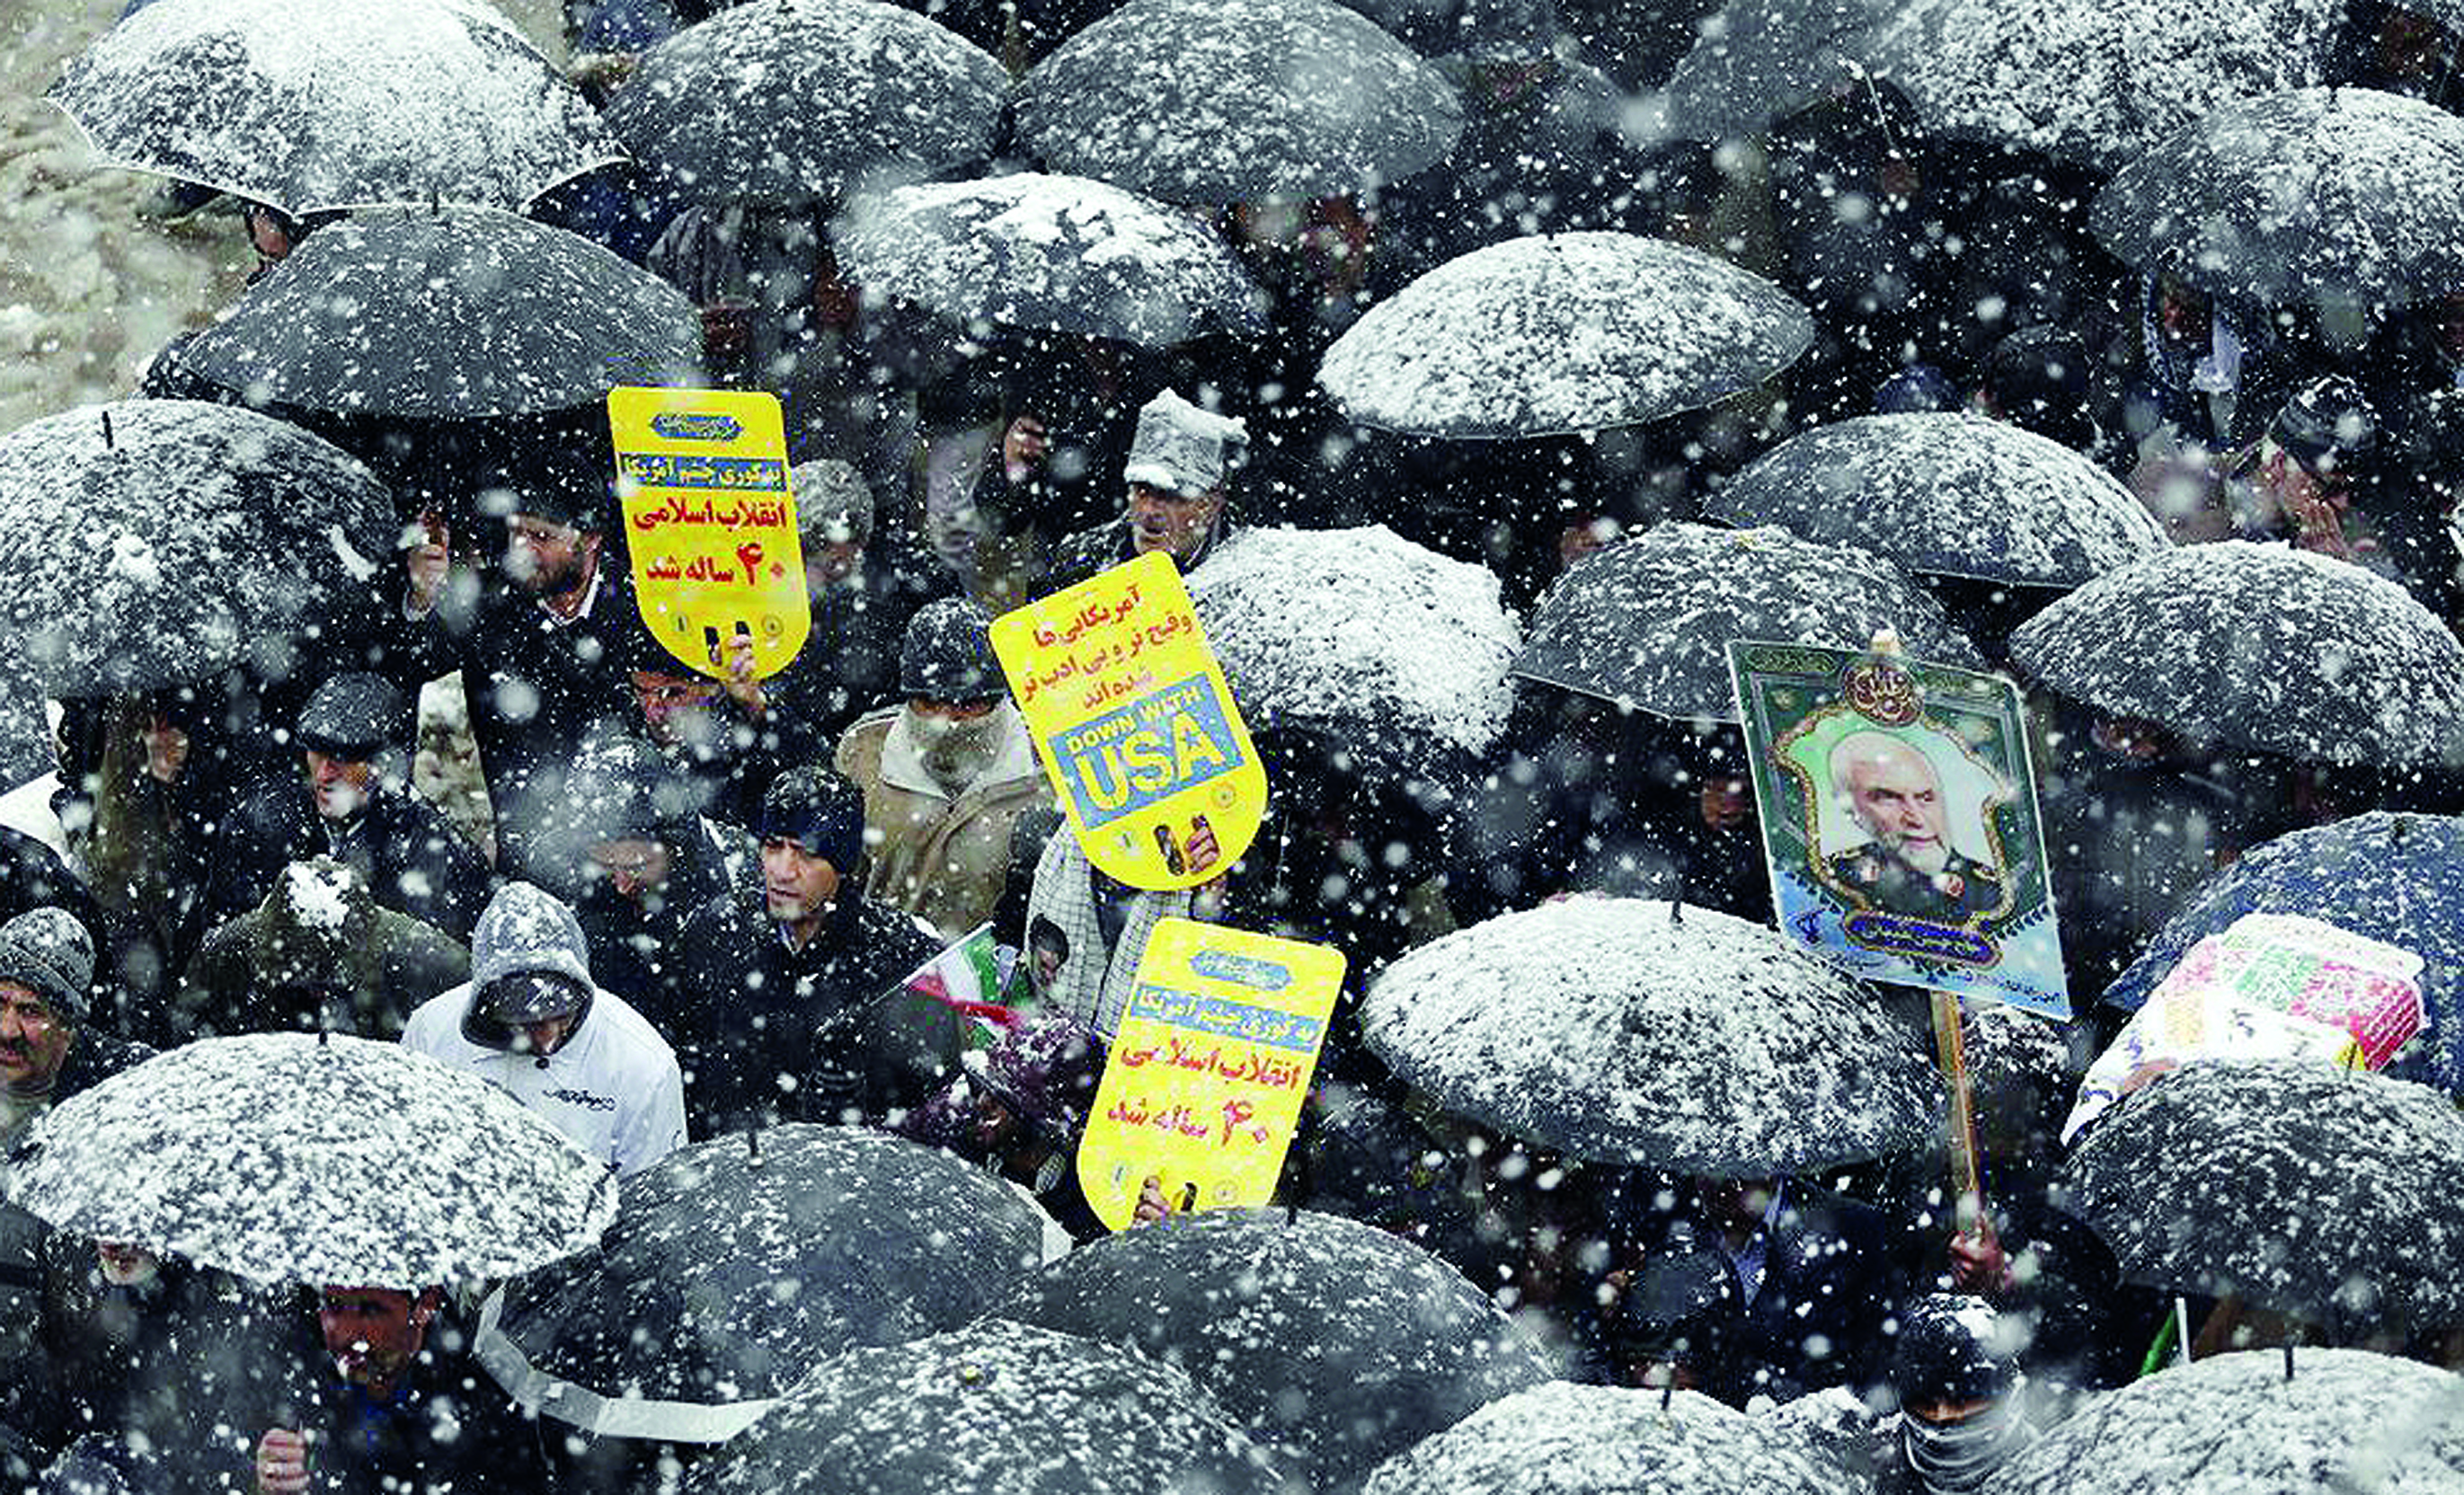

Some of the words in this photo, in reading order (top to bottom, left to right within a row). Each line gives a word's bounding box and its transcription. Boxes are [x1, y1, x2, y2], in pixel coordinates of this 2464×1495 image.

[634, 497, 714, 530] اسلامی
[716, 500, 787, 532] انقلاب
[646, 554, 681, 582] شد
[686, 556, 735, 582] ساله
[737, 543, 784, 586] ۴۰
[1146, 611, 1194, 646] وقیح
[1040, 654, 1079, 690] ادب
[1065, 710, 1137, 756] DOWN
[1139, 686, 1206, 726] WITH
[1075, 712, 1230, 812] USA
[1121, 1039, 1220, 1076] اسلامی
[1219, 1052, 1302, 1091] انقلاب
[1107, 1097, 1149, 1126] شد
[1153, 1105, 1209, 1137] ساله
[1222, 1099, 1270, 1147] ۴۰
